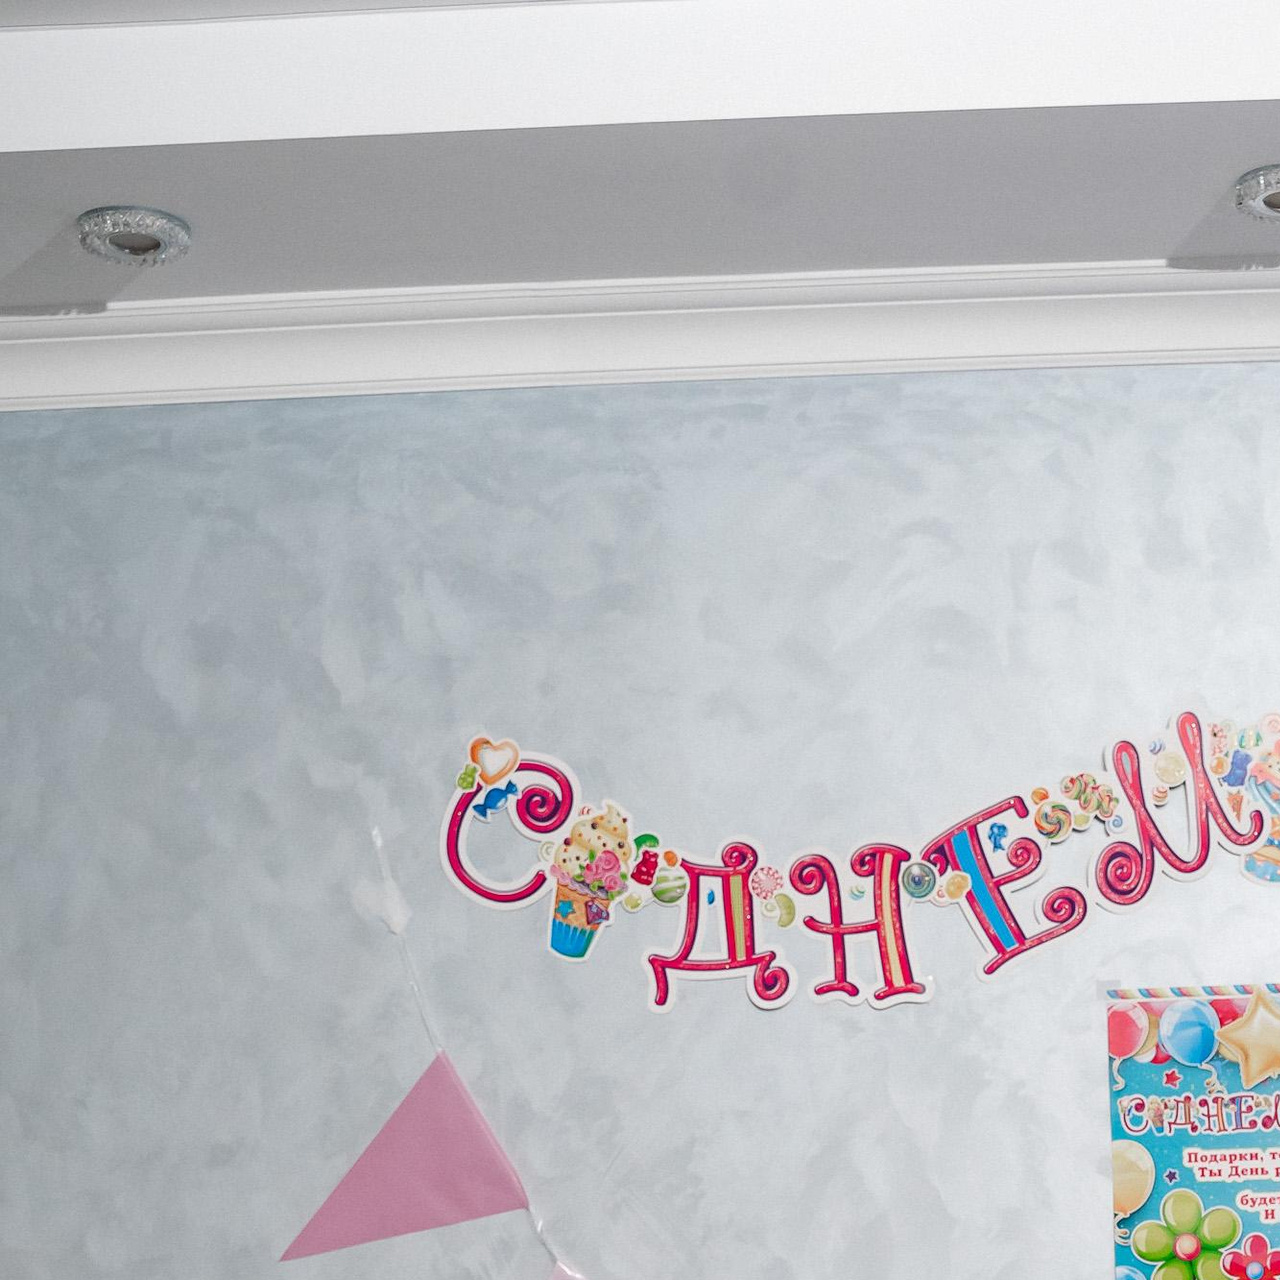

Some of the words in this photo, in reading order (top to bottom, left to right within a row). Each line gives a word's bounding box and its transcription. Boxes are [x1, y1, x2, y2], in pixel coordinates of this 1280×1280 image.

[445, 759, 574, 904] С
[650, 711, 1263, 1007] ДНЕМ
[1123, 1097, 1149, 1133] С
[1187, 1151, 1264, 1164] Подарки,
[1198, 1167, 1222, 1178] Ты
[1228, 1165, 1269, 1178] День
[1264, 1209, 1276, 1220] И
